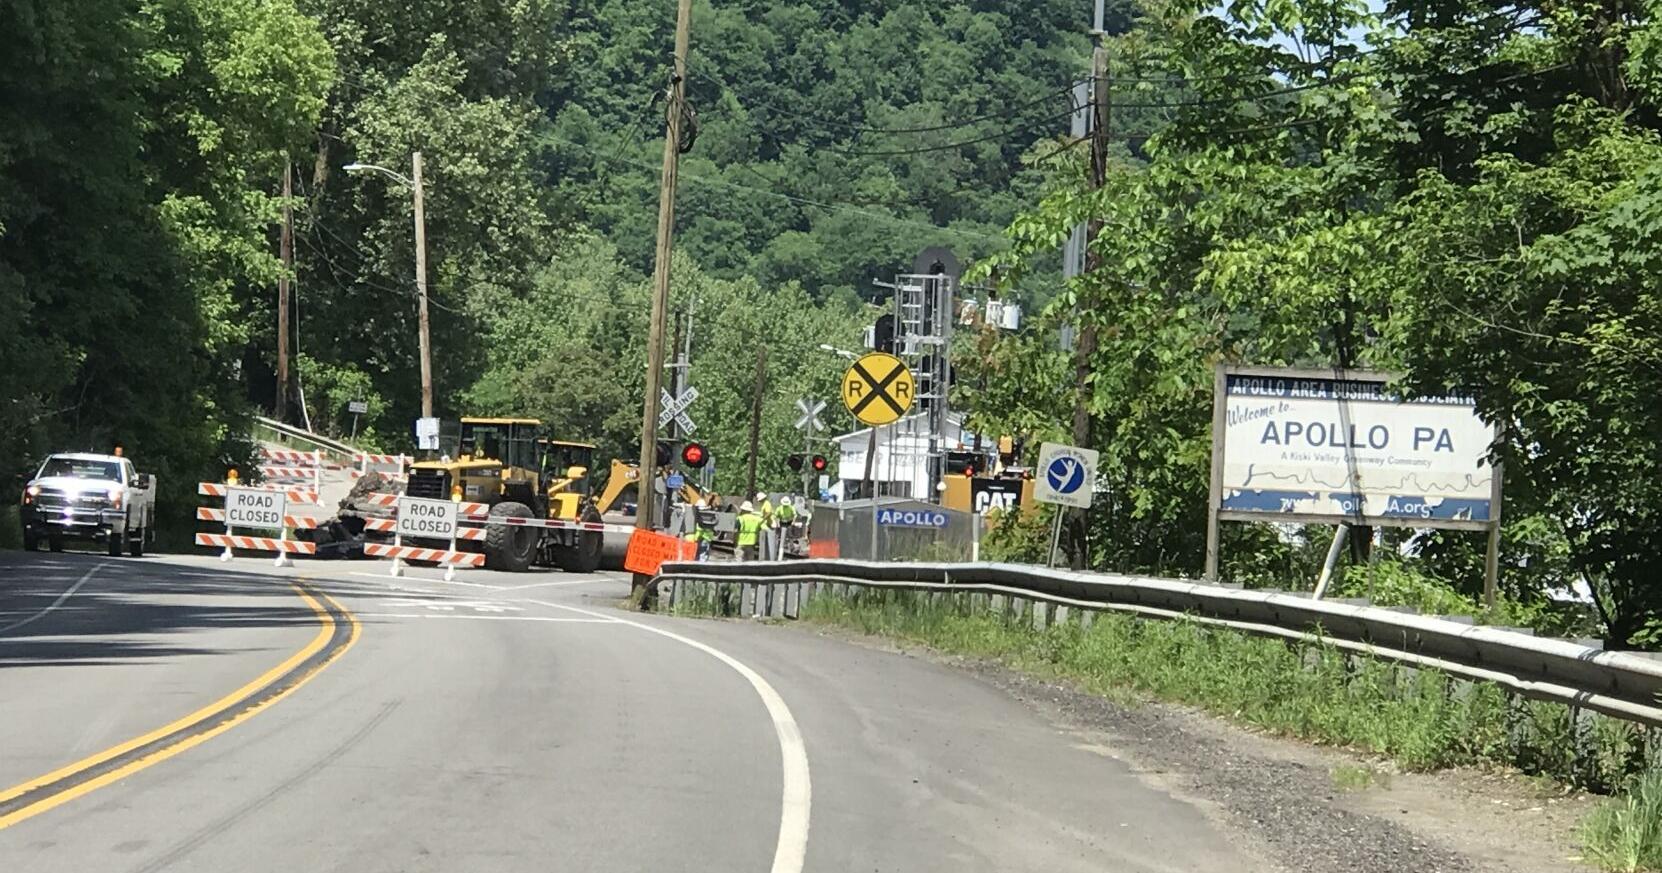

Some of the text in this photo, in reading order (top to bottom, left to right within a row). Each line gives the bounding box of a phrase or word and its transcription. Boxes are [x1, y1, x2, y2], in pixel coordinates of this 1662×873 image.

[849, 381, 909, 399] R R
[1232, 378, 1285, 396] APOLLO
[1291, 381, 1326, 398] AREA
[660, 391, 694, 422] ROSSING
[1227, 405, 1275, 427] Welcome
[1261, 421, 1455, 452] APOLLO PA
[1281, 452, 1288, 460] A
[1290, 452, 1311, 462] Kiski
[1315, 453, 1340, 464] Valley
[1388, 456, 1433, 469] Community
[238, 494, 273, 509] ROAD
[975, 491, 1017, 517] CAT
[229, 509, 279, 524] CLOSED
[410, 504, 445, 518] ROAD
[881, 511, 945, 527] APOLLO
[402, 518, 451, 534] CLOSED
